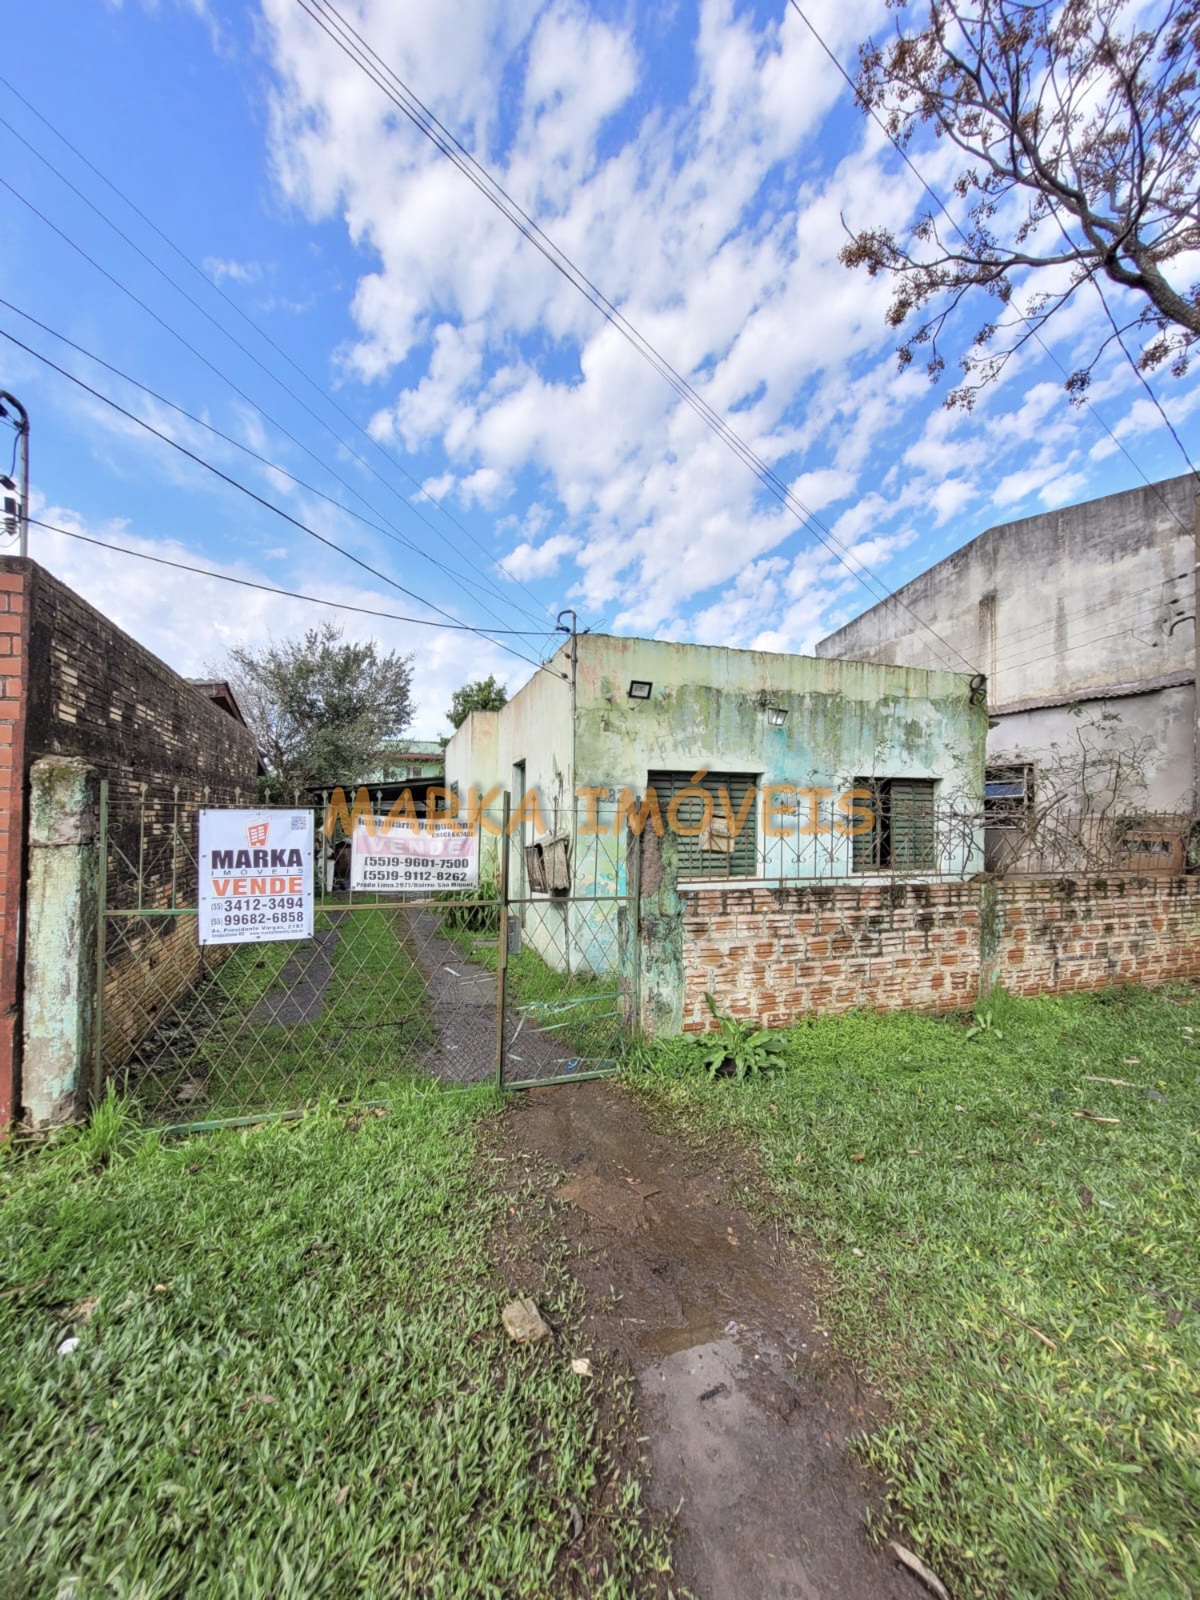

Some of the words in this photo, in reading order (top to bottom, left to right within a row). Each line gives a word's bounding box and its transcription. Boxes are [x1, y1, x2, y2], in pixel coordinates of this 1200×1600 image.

[369, 839, 462, 856] VENDE
[211, 848, 303, 870] MARKA
[364, 856, 469, 869] (55)9-9601-7500
[363, 870, 467, 882] (55)9-9112-8262
[212, 877, 303, 896] VENDE
[211, 902, 223, 911] (55)
[224, 897, 304, 912] 3412-3494
[224, 911, 304, 926] 99682-6858
